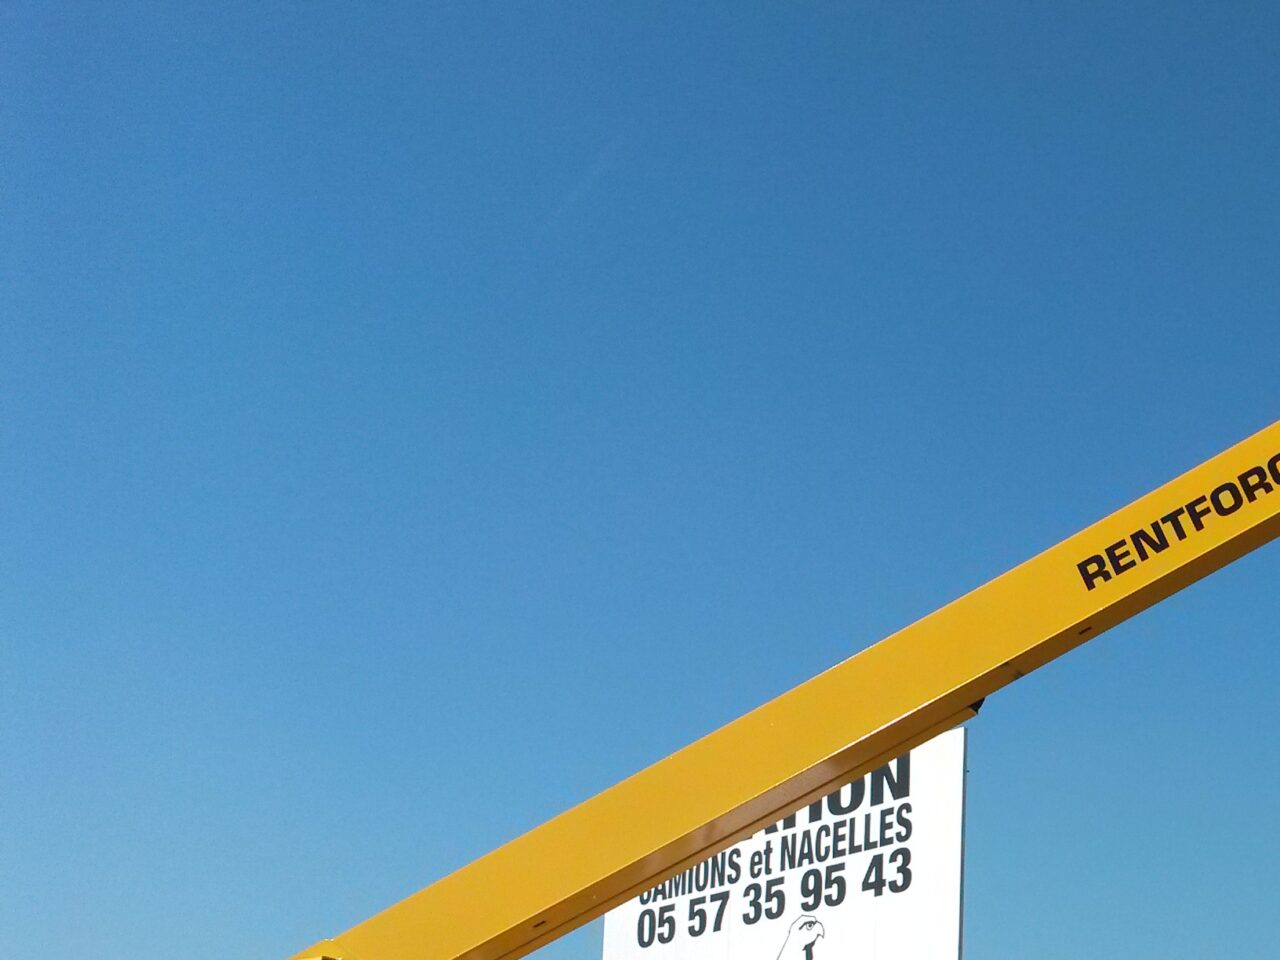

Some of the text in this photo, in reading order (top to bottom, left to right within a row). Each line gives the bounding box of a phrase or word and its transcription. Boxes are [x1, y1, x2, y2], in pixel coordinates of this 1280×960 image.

[750, 840, 772, 879] et
[780, 803, 912, 871] NACELLES
[637, 847, 912, 948] 05 57 35 95 43
